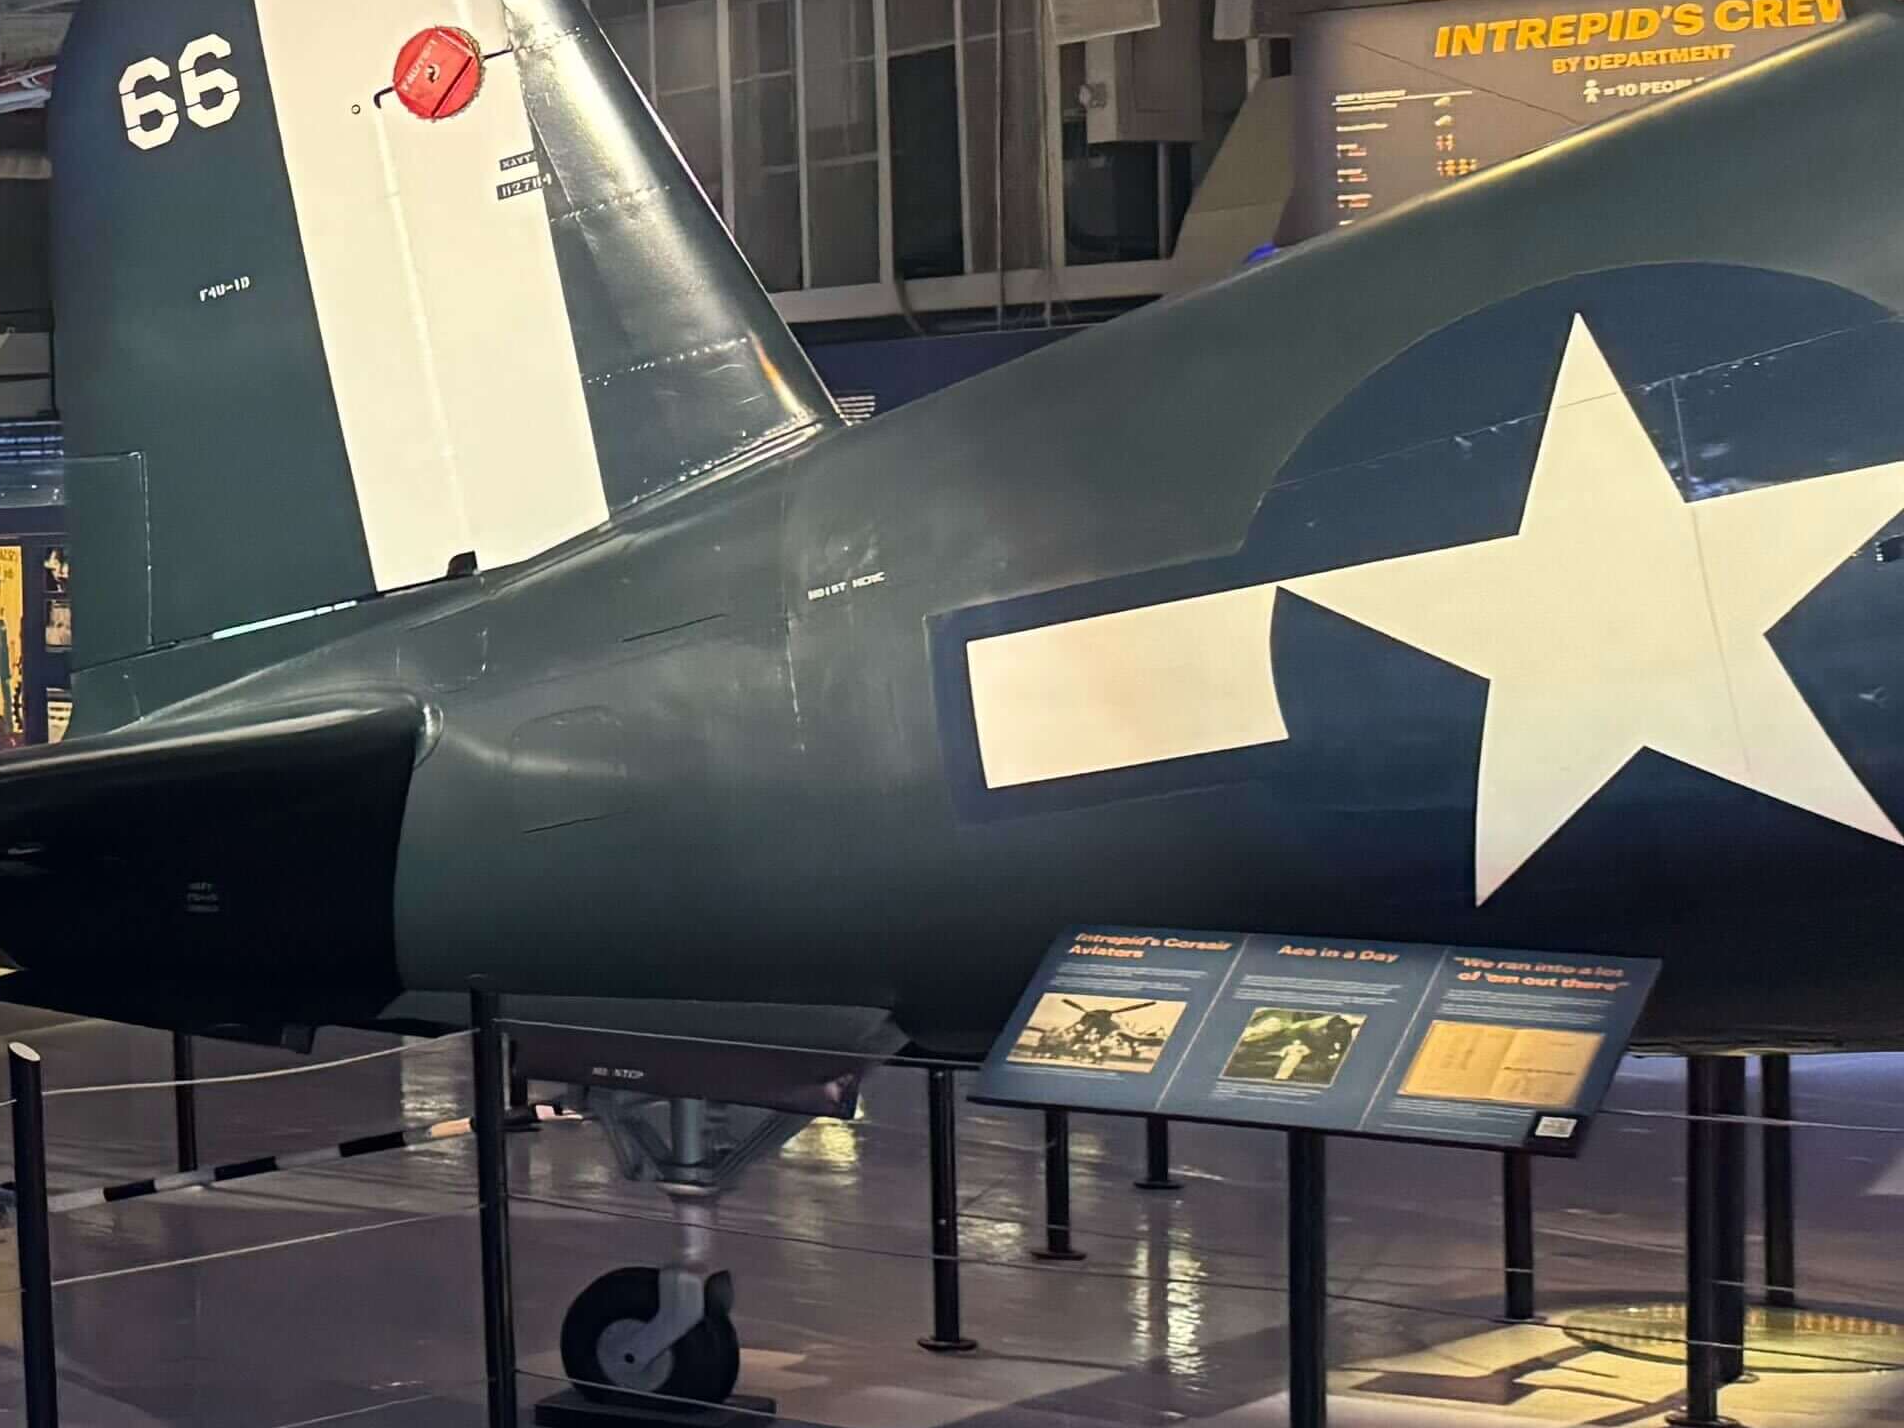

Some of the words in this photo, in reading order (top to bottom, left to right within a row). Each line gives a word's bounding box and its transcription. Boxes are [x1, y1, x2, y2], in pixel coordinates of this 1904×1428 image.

[1433, 2, 1704, 58] INTREPID'S
[1552, 56, 1582, 74] BY
[1585, 44, 1736, 71] DEPARTMENT
[119, 33, 240, 150] 66
[1639, 77, 1704, 95] PEOP
[1074, 932, 1161, 947] Intrepid's
[1163, 938, 1233, 951] Corsair
[1068, 944, 1145, 959] Aviators
[1278, 944, 1317, 958] Ace
[1320, 947, 1339, 959] in
[1342, 950, 1355, 960] a
[1359, 950, 1400, 964] Day
[1496, 960, 1531, 972] ran
[1534, 961, 1576, 974] into
[1594, 966, 1625, 978] lot
[1457, 970, 1482, 983] of
[1522, 975, 1557, 989] out
